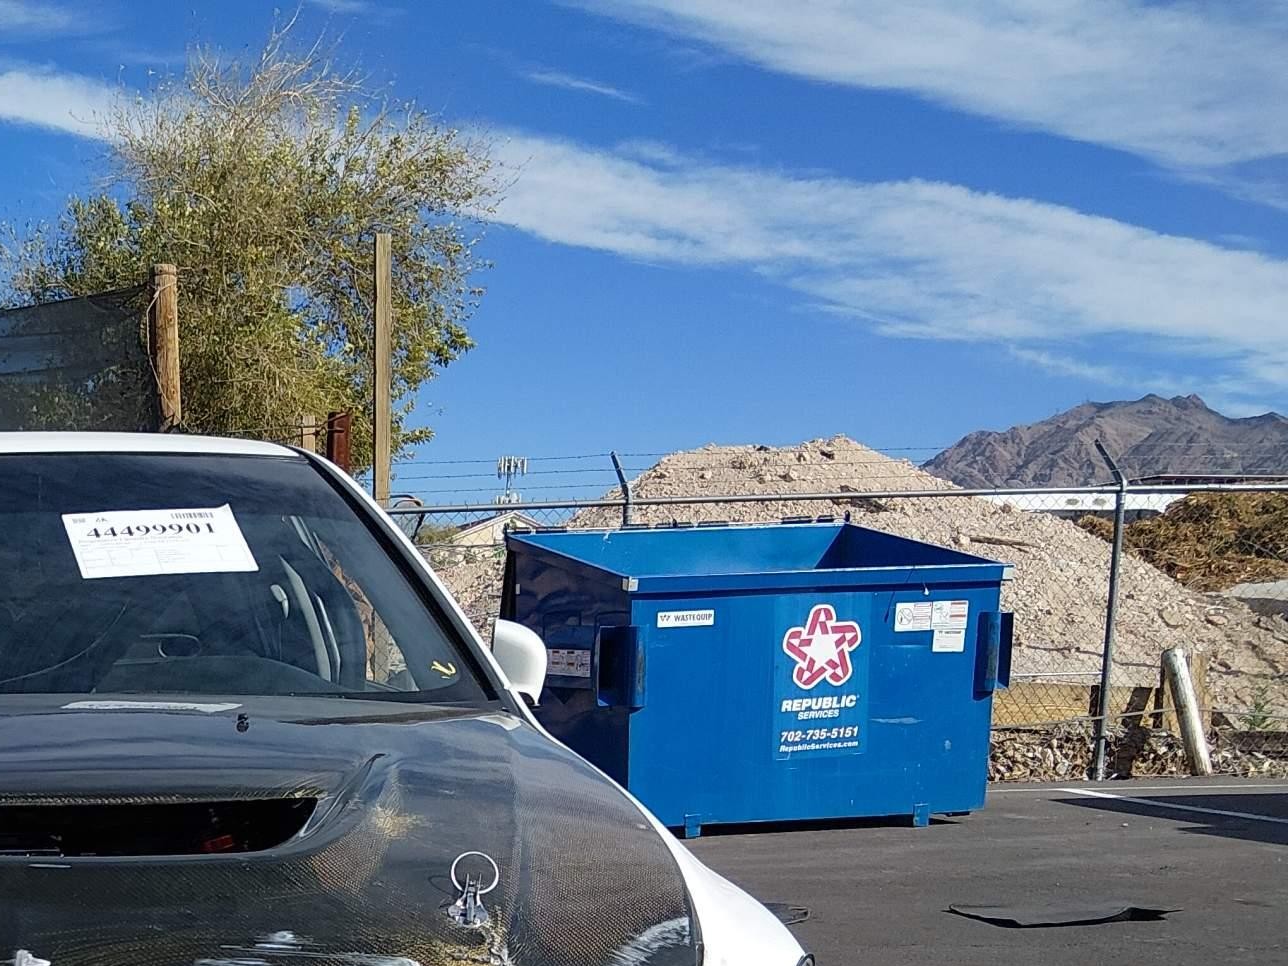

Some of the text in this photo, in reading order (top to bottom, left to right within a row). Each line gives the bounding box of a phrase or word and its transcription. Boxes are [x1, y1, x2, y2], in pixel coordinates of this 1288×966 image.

[86, 522, 216, 539] 44499901
[673, 613, 713, 622] WASTEQUIP
[781, 694, 857, 713] REPUBLIC
[797, 709, 840, 720] SERVICES
[780, 725, 859, 743] 702-735-5151
[779, 740, 859, 753] RepublicServices.com
